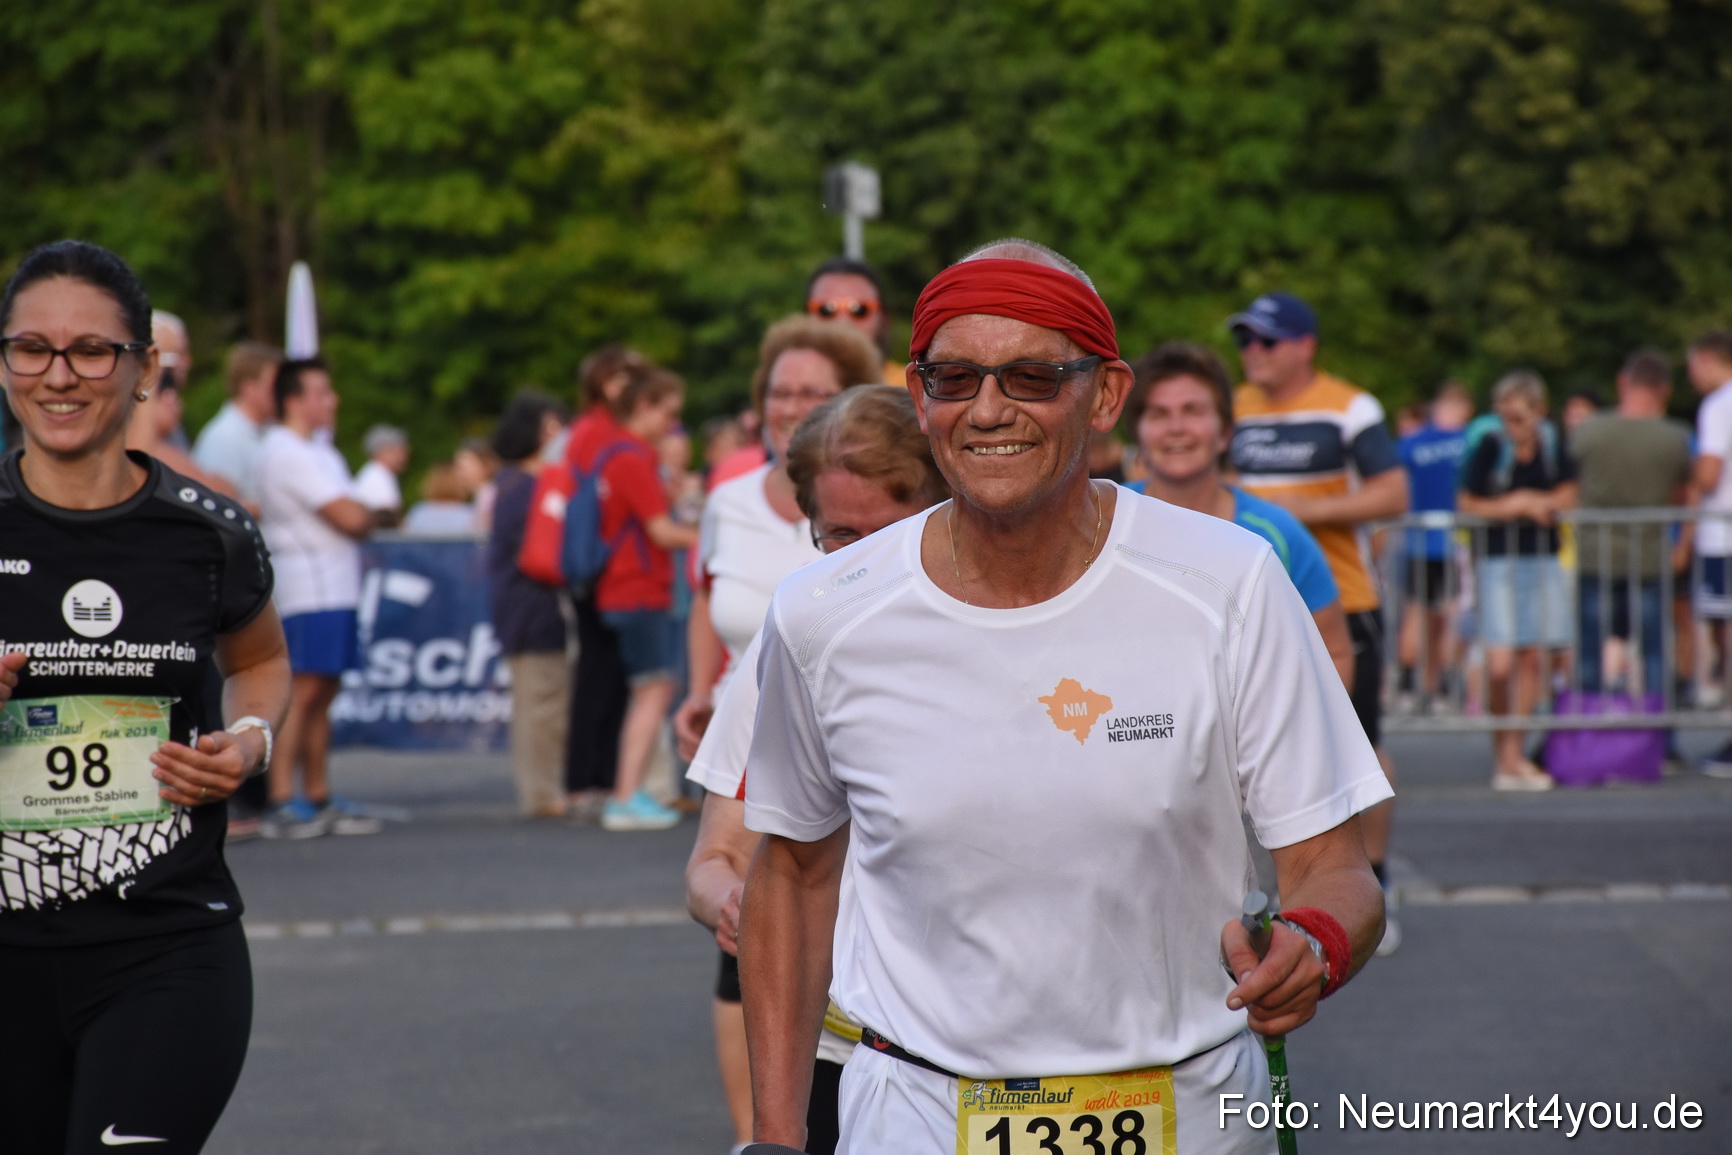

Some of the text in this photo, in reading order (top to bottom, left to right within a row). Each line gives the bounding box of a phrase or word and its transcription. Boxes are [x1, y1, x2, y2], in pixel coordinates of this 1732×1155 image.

[831, 567, 868, 591] JAKO
[29, 660, 155, 677] SCHOTTERWERKE
[1063, 702, 1088, 718] NM
[15, 720, 85, 738] firmenlauf
[1106, 713, 1174, 730] LANDKREIS
[125, 726, 157, 738] 2019
[1108, 727, 1175, 743] NEUMARKT
[46, 743, 111, 791] 98
[23, 790, 138, 807] Grommes Sabine
[55, 805, 109, 816] Bärnreuther
[989, 1087, 1074, 1104] firmenlauf
[1085, 1090, 1160, 1111] walk 2019
[985, 1109, 1147, 1155] 1338
